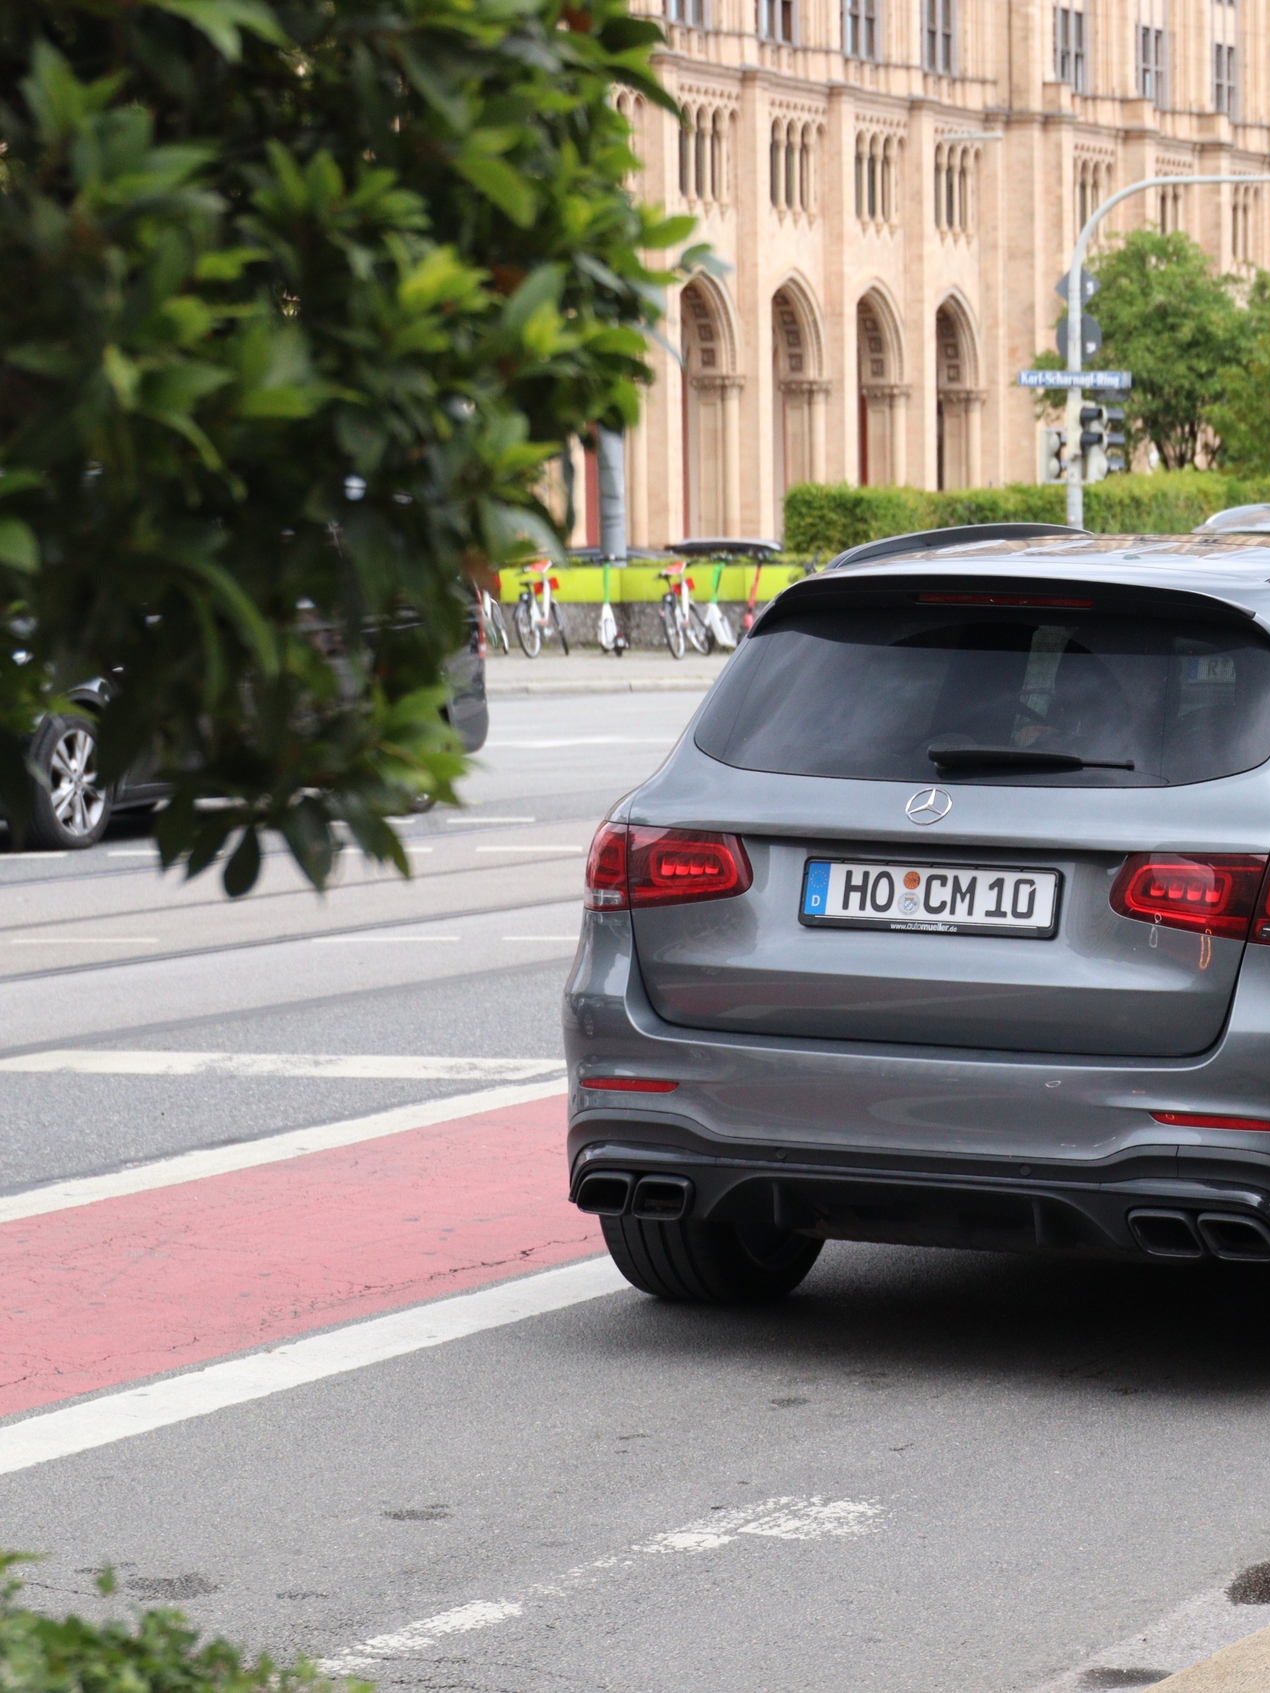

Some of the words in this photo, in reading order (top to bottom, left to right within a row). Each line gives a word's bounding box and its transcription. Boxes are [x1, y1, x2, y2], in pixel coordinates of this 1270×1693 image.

[1021, 371, 1119, 388] Karl-Scharnagl-Ring
[811, 895, 820, 907] D
[841, 870, 895, 912] HO
[923, 873, 977, 917] CM
[984, 877, 1036, 919] 10
[890, 922, 958, 932] www.automueller.de
